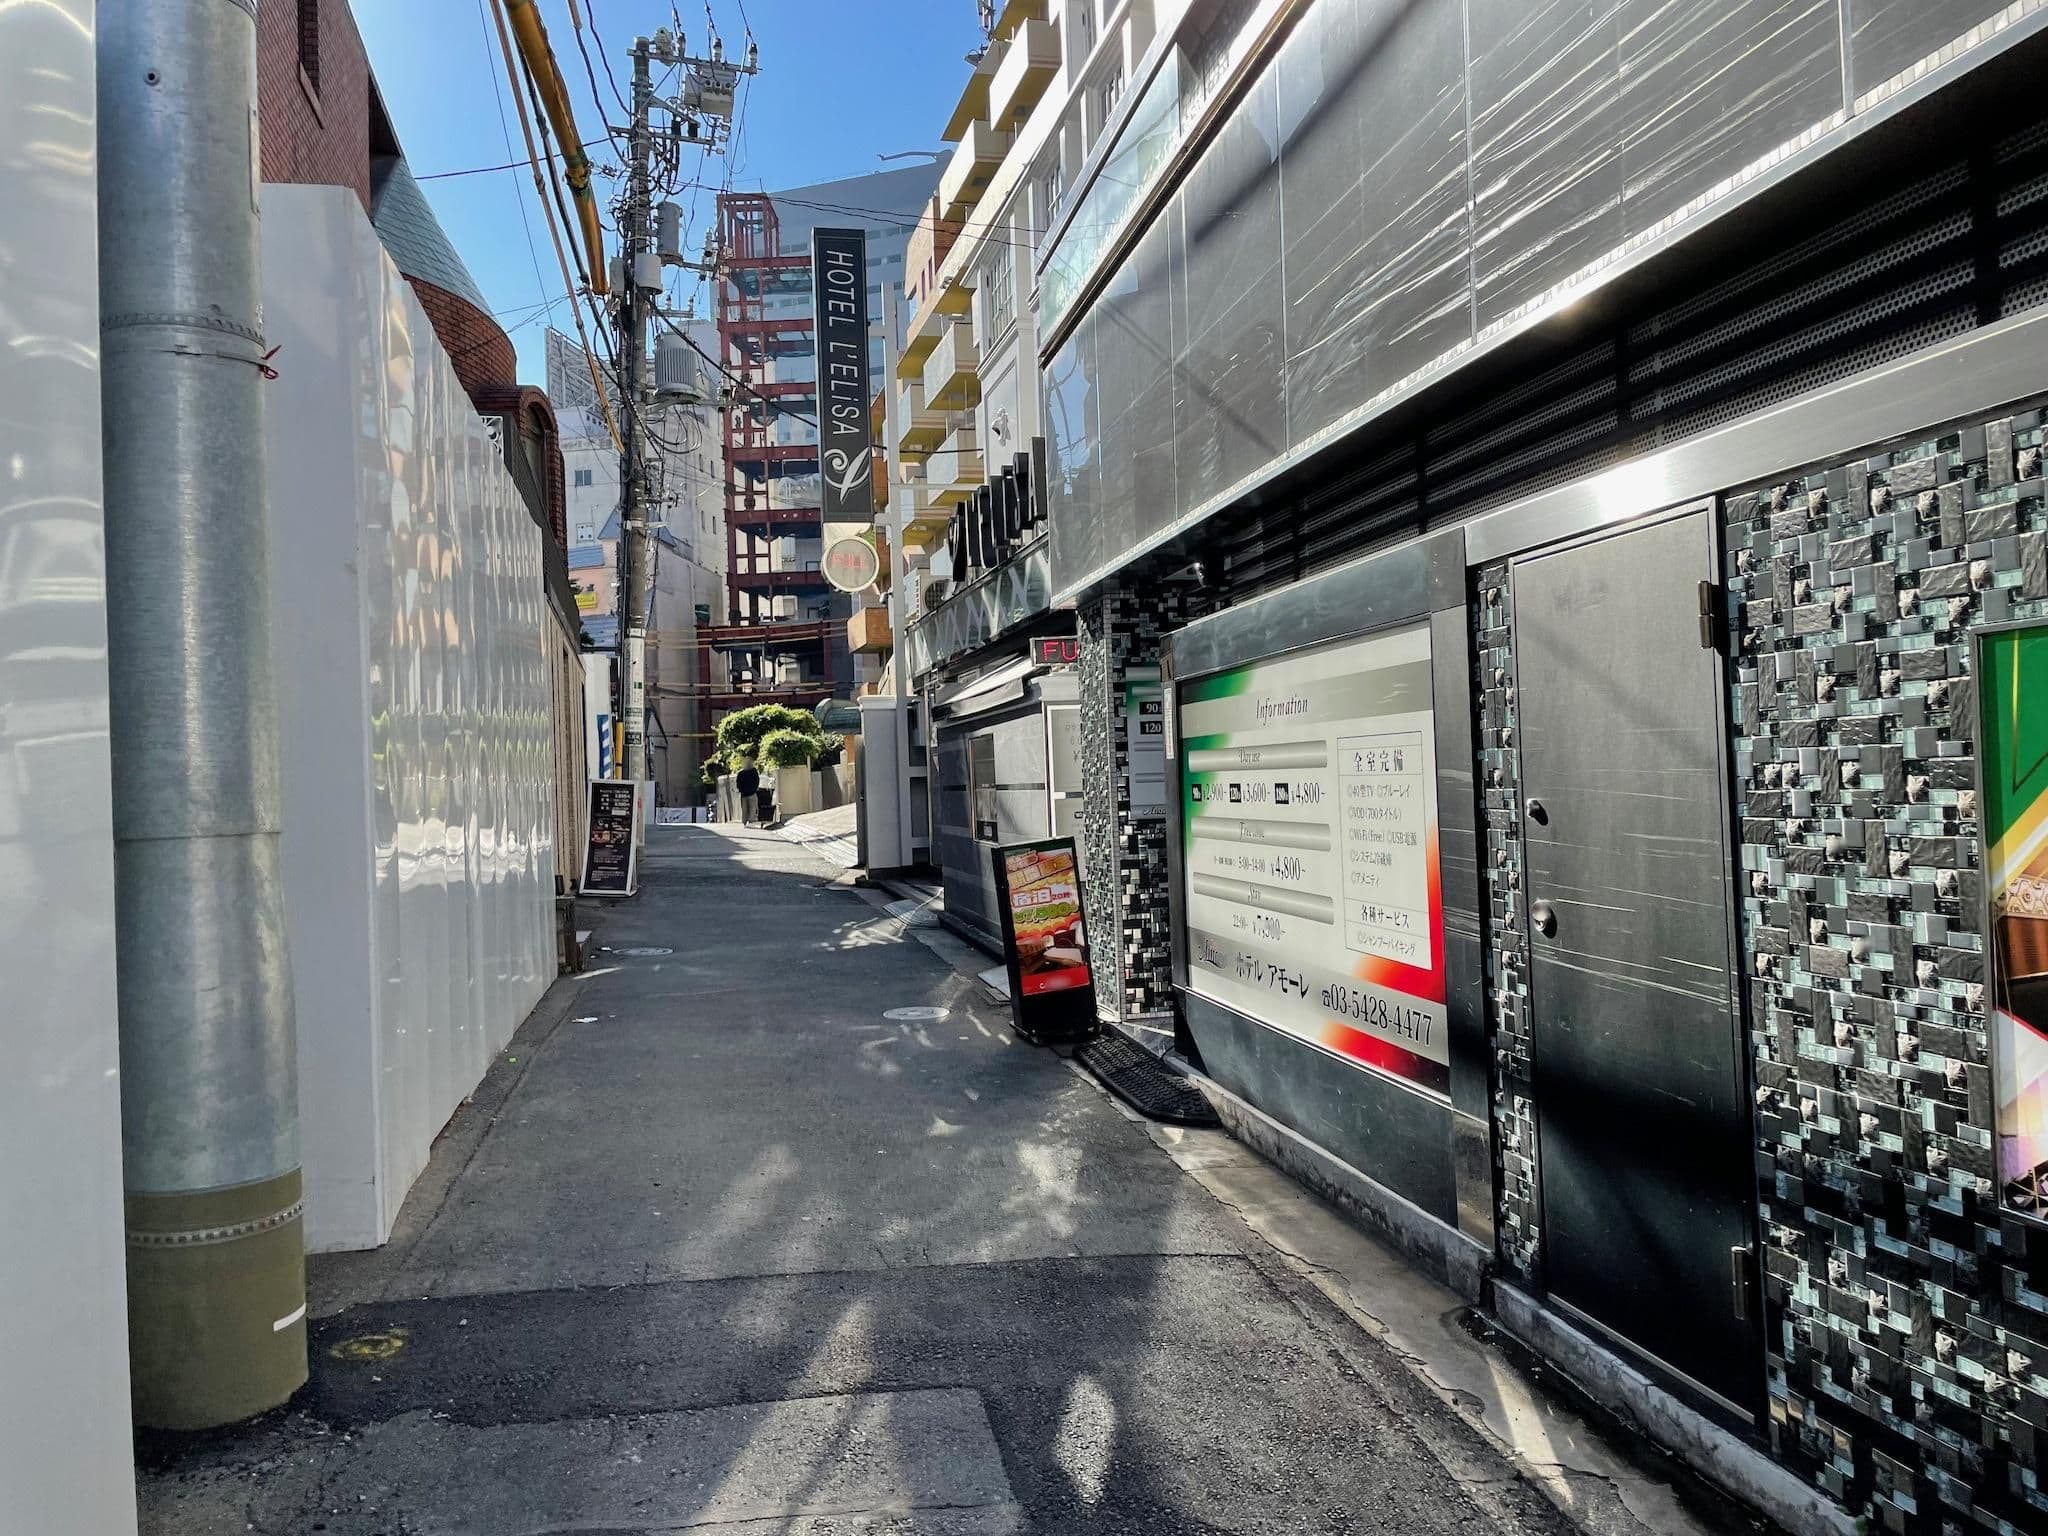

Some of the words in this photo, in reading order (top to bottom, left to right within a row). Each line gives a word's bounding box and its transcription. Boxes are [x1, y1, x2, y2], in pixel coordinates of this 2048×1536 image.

[826, 250, 855, 327] HOTEL
[1256, 694, 1308, 726] Information
[1145, 723, 1162, 733] 120
[1354, 749, 1403, 772] 全室完備
[1361, 904, 1410, 928] 各種サービス
[1236, 951, 1264, 982] ホテル
[1267, 964, 1310, 1000] アモーレ
[1331, 984, 1432, 1046] 03-5428-4477
